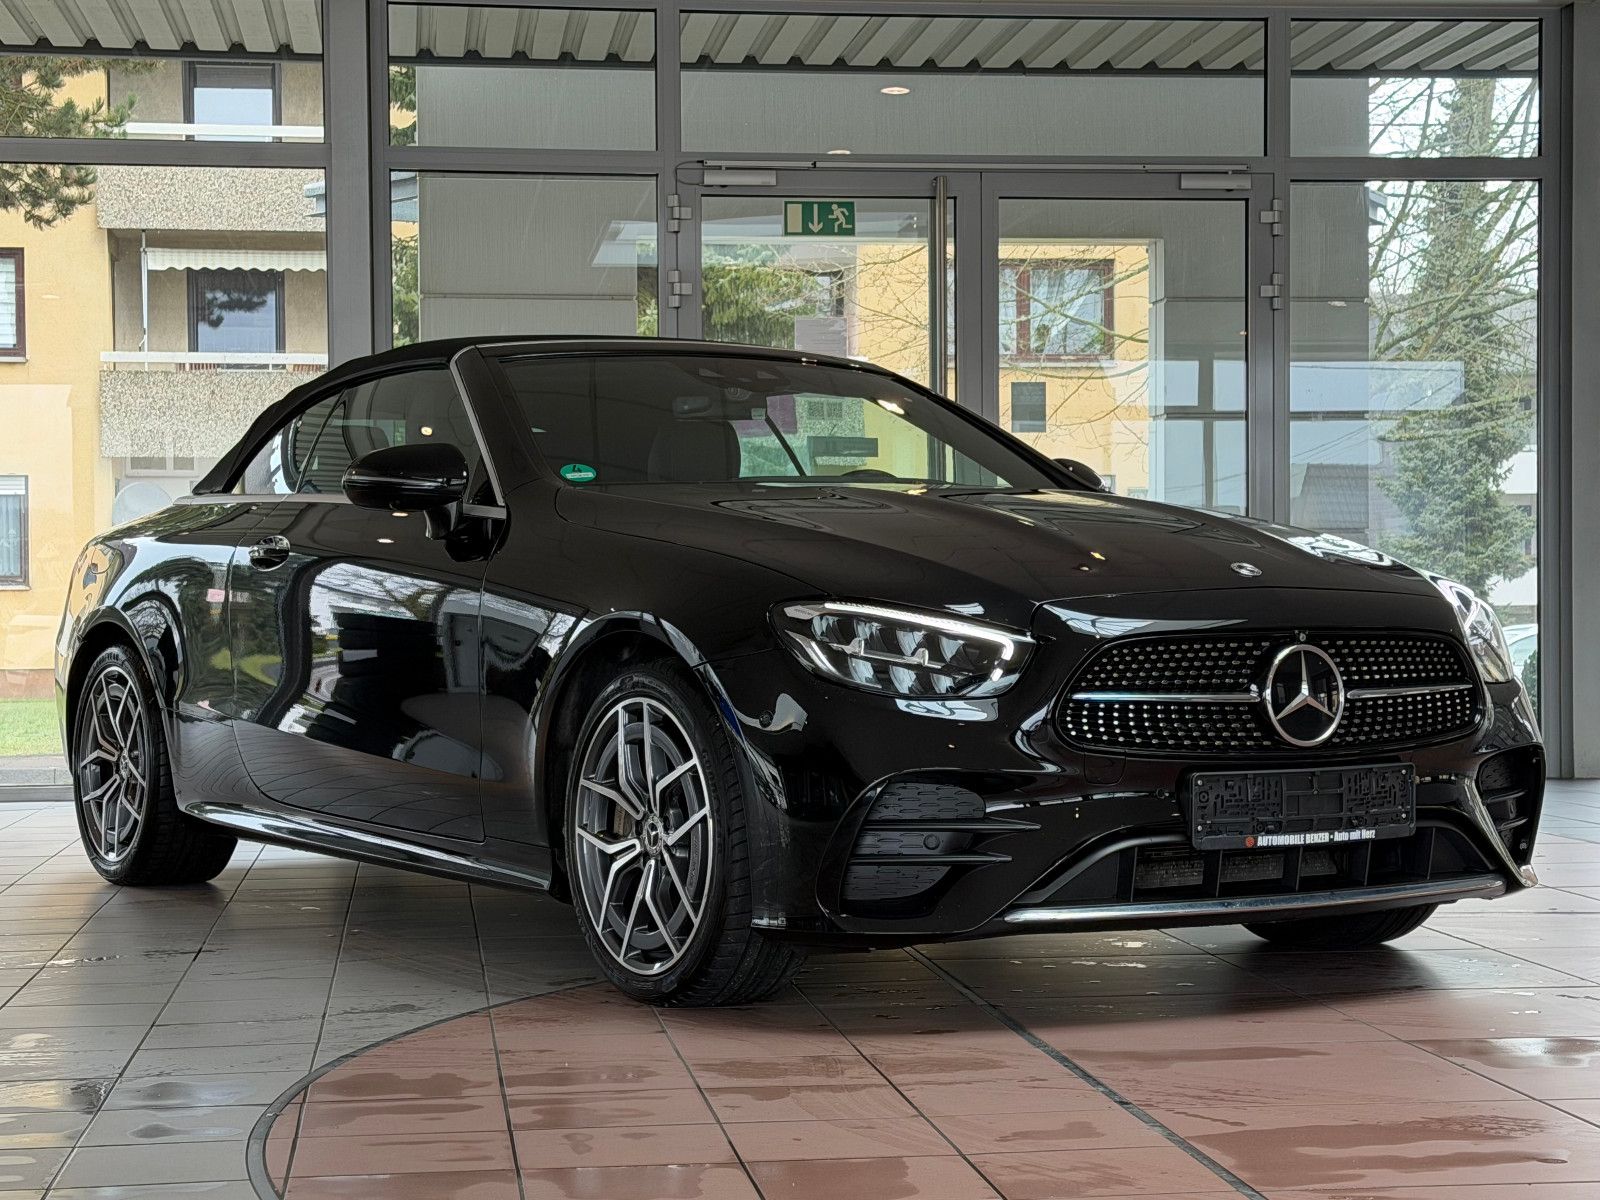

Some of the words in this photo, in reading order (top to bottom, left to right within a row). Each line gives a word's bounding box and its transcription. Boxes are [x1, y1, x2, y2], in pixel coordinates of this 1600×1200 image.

[1257, 834, 1304, 846] AUTOMOBILE
[1334, 831, 1349, 841] Auto
[1350, 829, 1361, 840] mit
[1361, 829, 1376, 839] Herz
